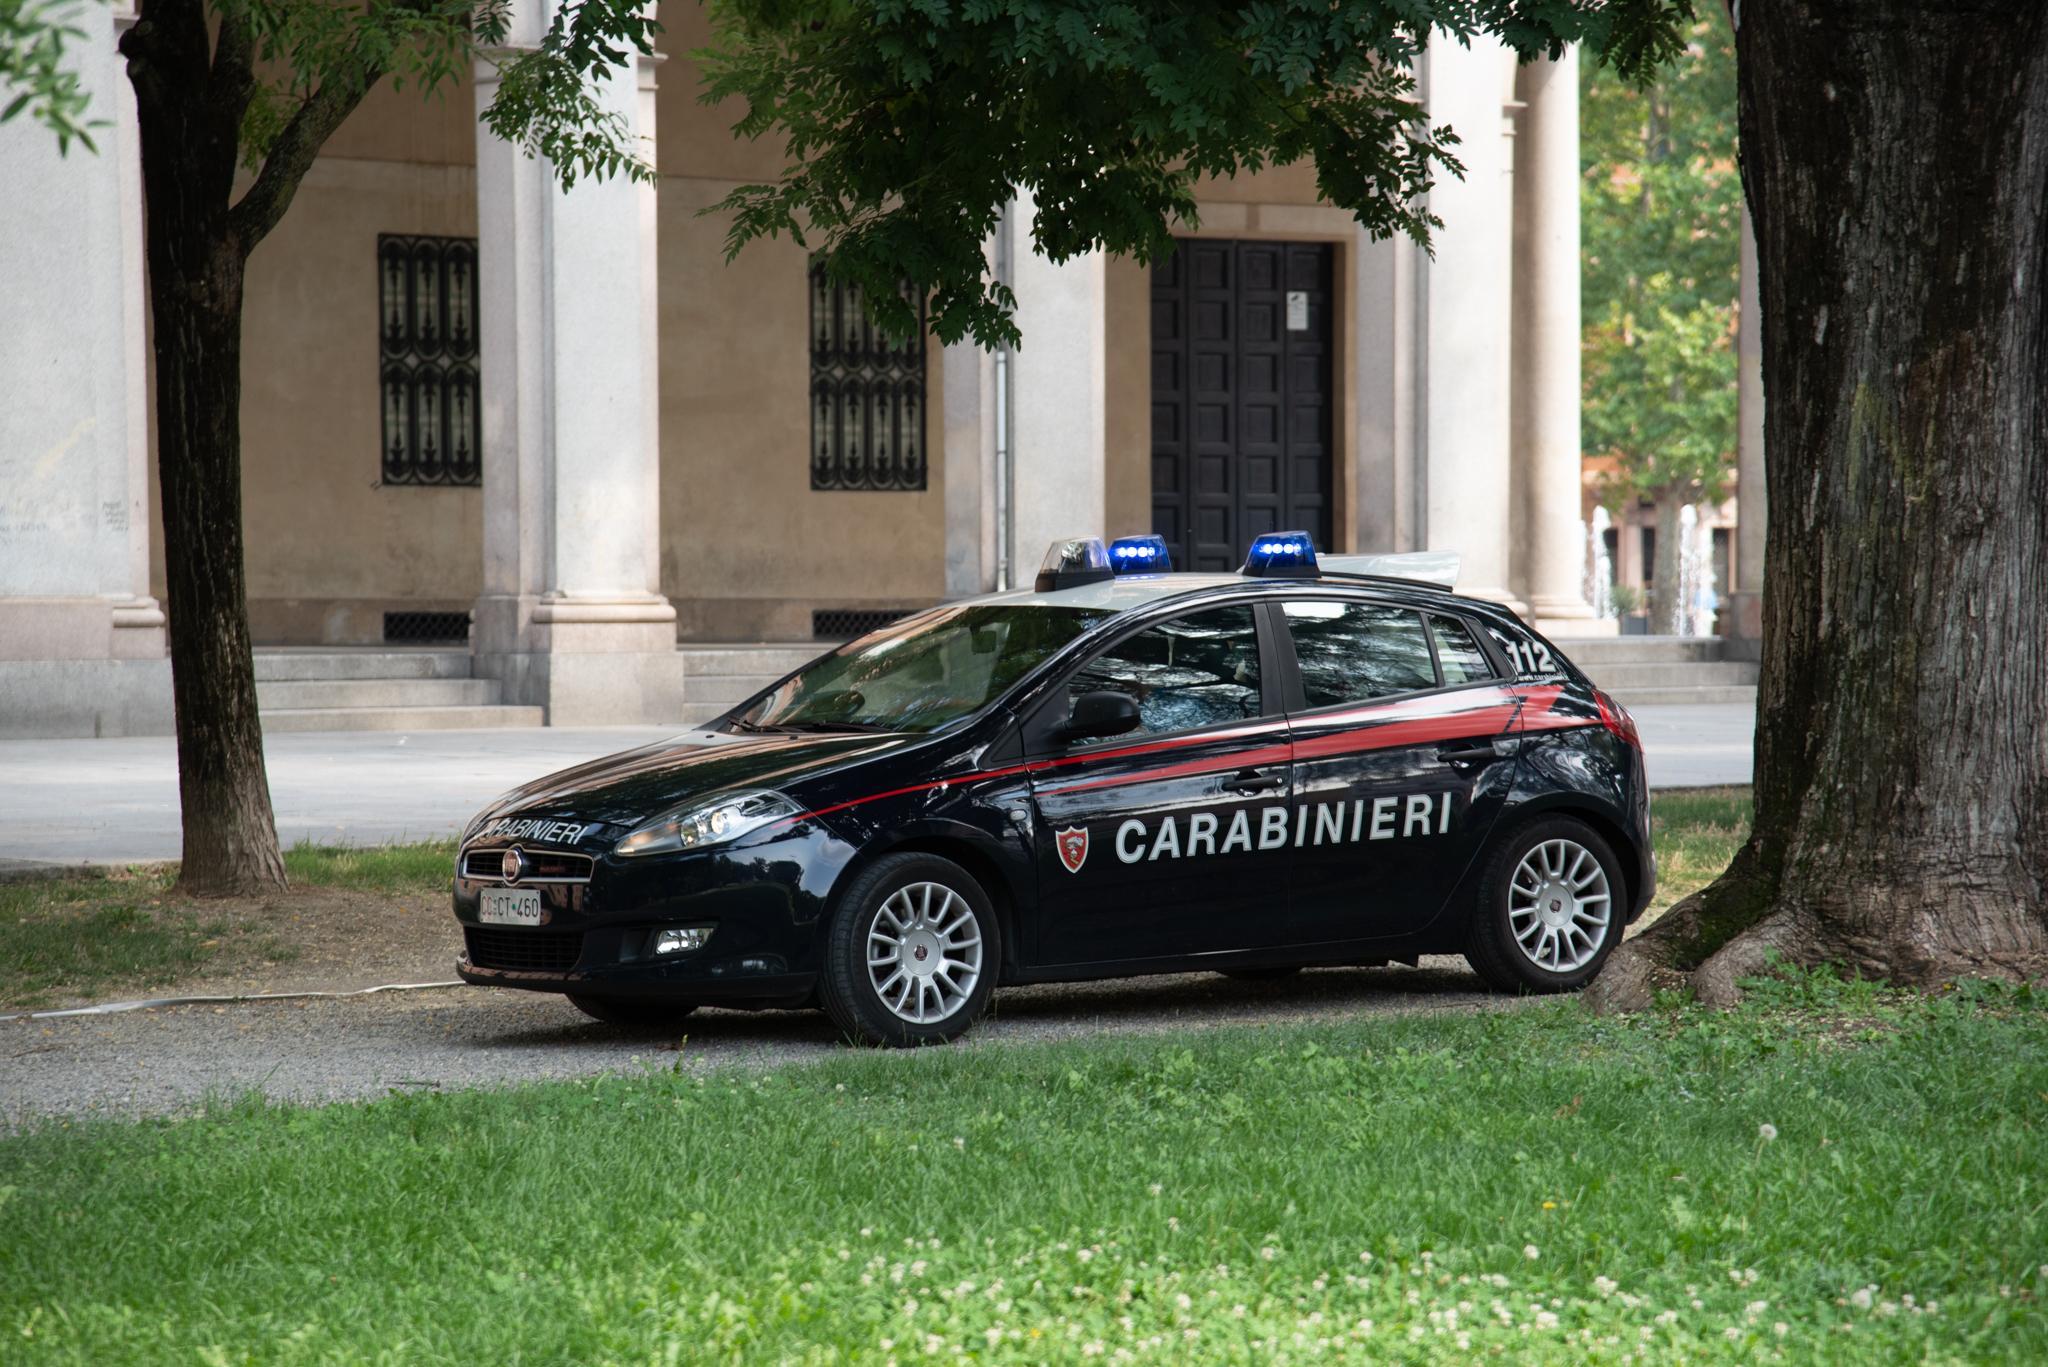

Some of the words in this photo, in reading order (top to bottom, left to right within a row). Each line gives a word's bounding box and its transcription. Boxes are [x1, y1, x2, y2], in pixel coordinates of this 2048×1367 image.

[1505, 640, 1557, 673] 112
[479, 817, 589, 845] ARABINIERI
[1115, 791, 1453, 864] CARABINIERI
